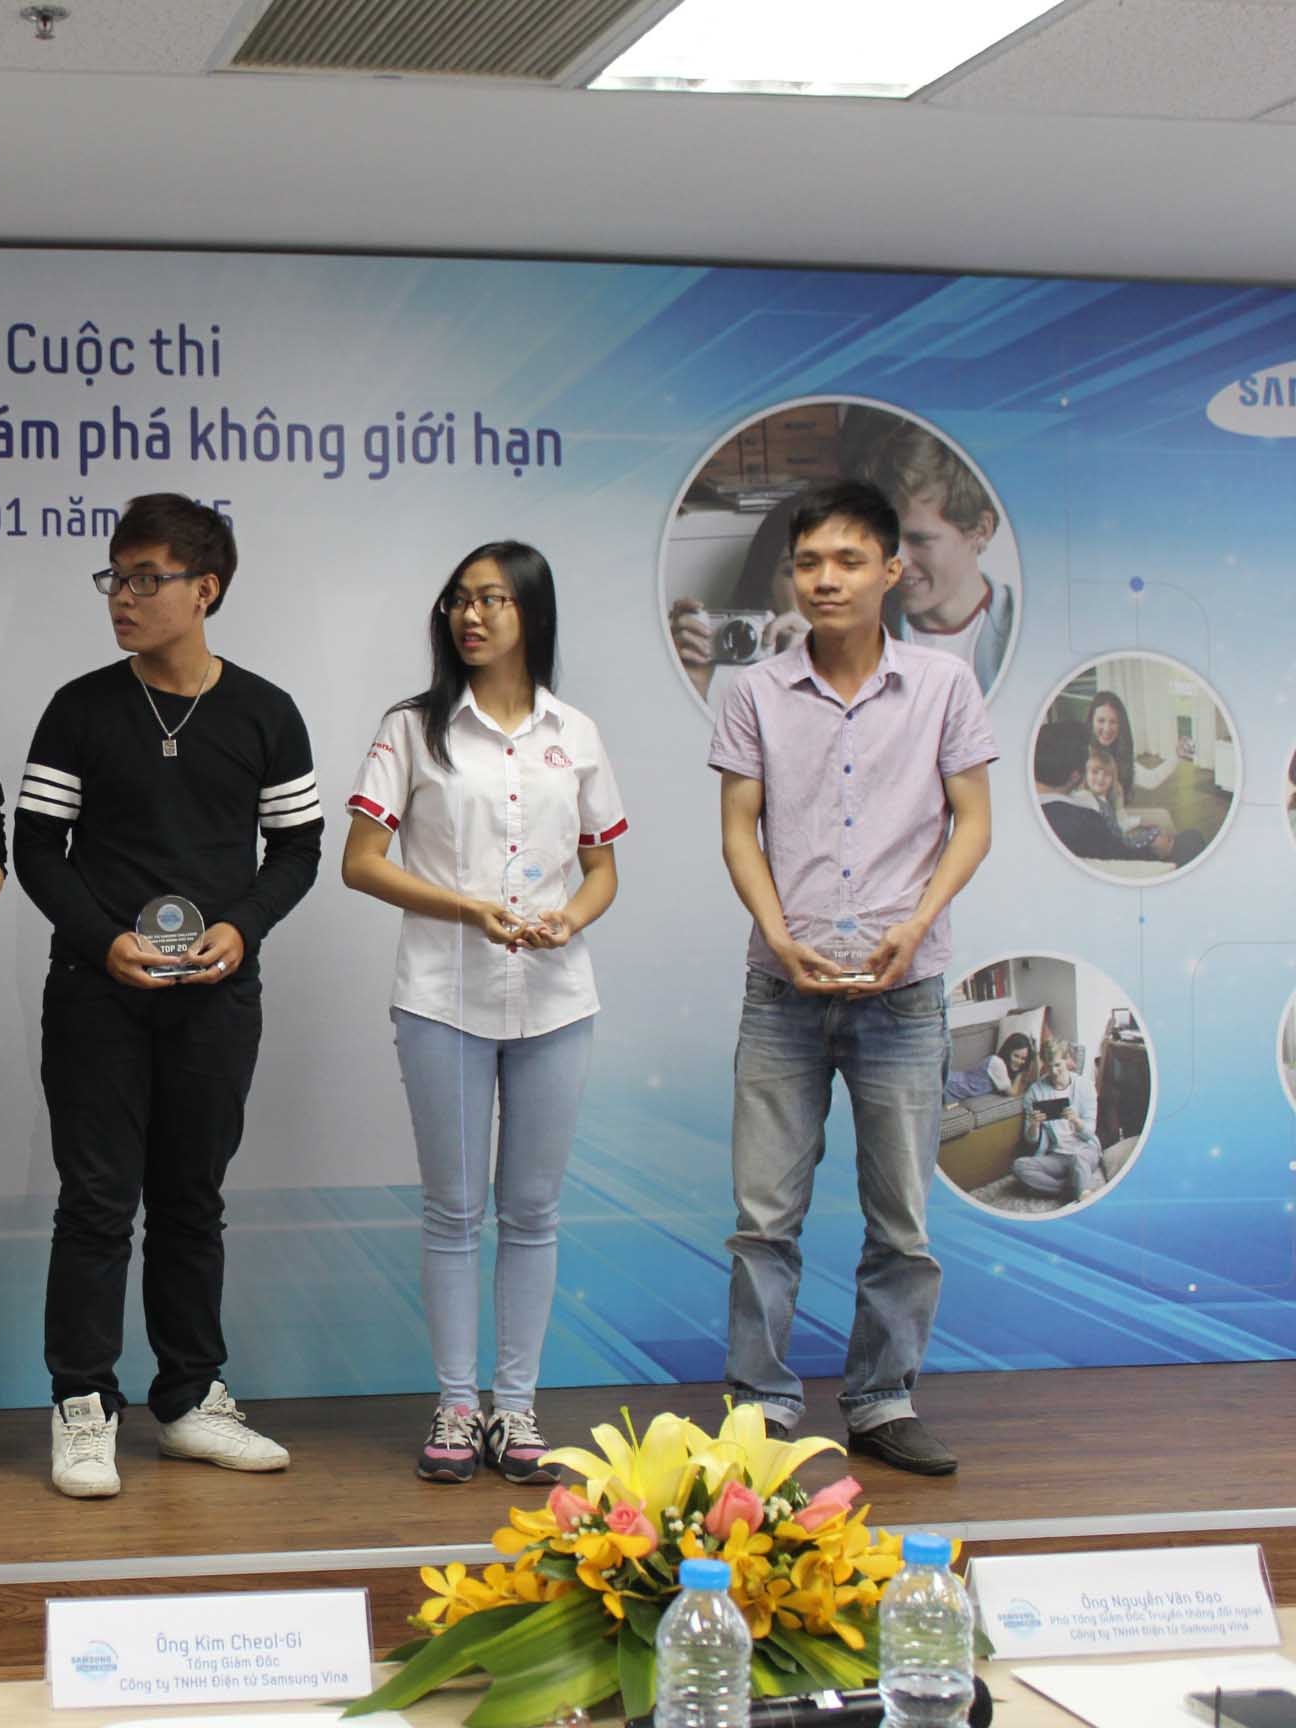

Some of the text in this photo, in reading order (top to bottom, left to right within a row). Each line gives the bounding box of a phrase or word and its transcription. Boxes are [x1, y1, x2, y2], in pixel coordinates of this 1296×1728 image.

[7, 320, 134, 386] Cuộc
[149, 323, 221, 377] thi
[80, 405, 171, 476] phá
[190, 406, 345, 480] không
[363, 411, 455, 480] giới
[474, 411, 562, 477] hạn
[41, 495, 120, 538] năm
[160, 945, 176, 953] TOP
[157, 1631, 302, 1657] Ông Kim Cheol-Gi
[120, 1677, 152, 1694] Công
[155, 1678, 170, 1693] ty
[175, 1675, 207, 1688] TNHH
[262, 1672, 318, 1688] Samsung
[321, 1670, 349, 1684] Vina
